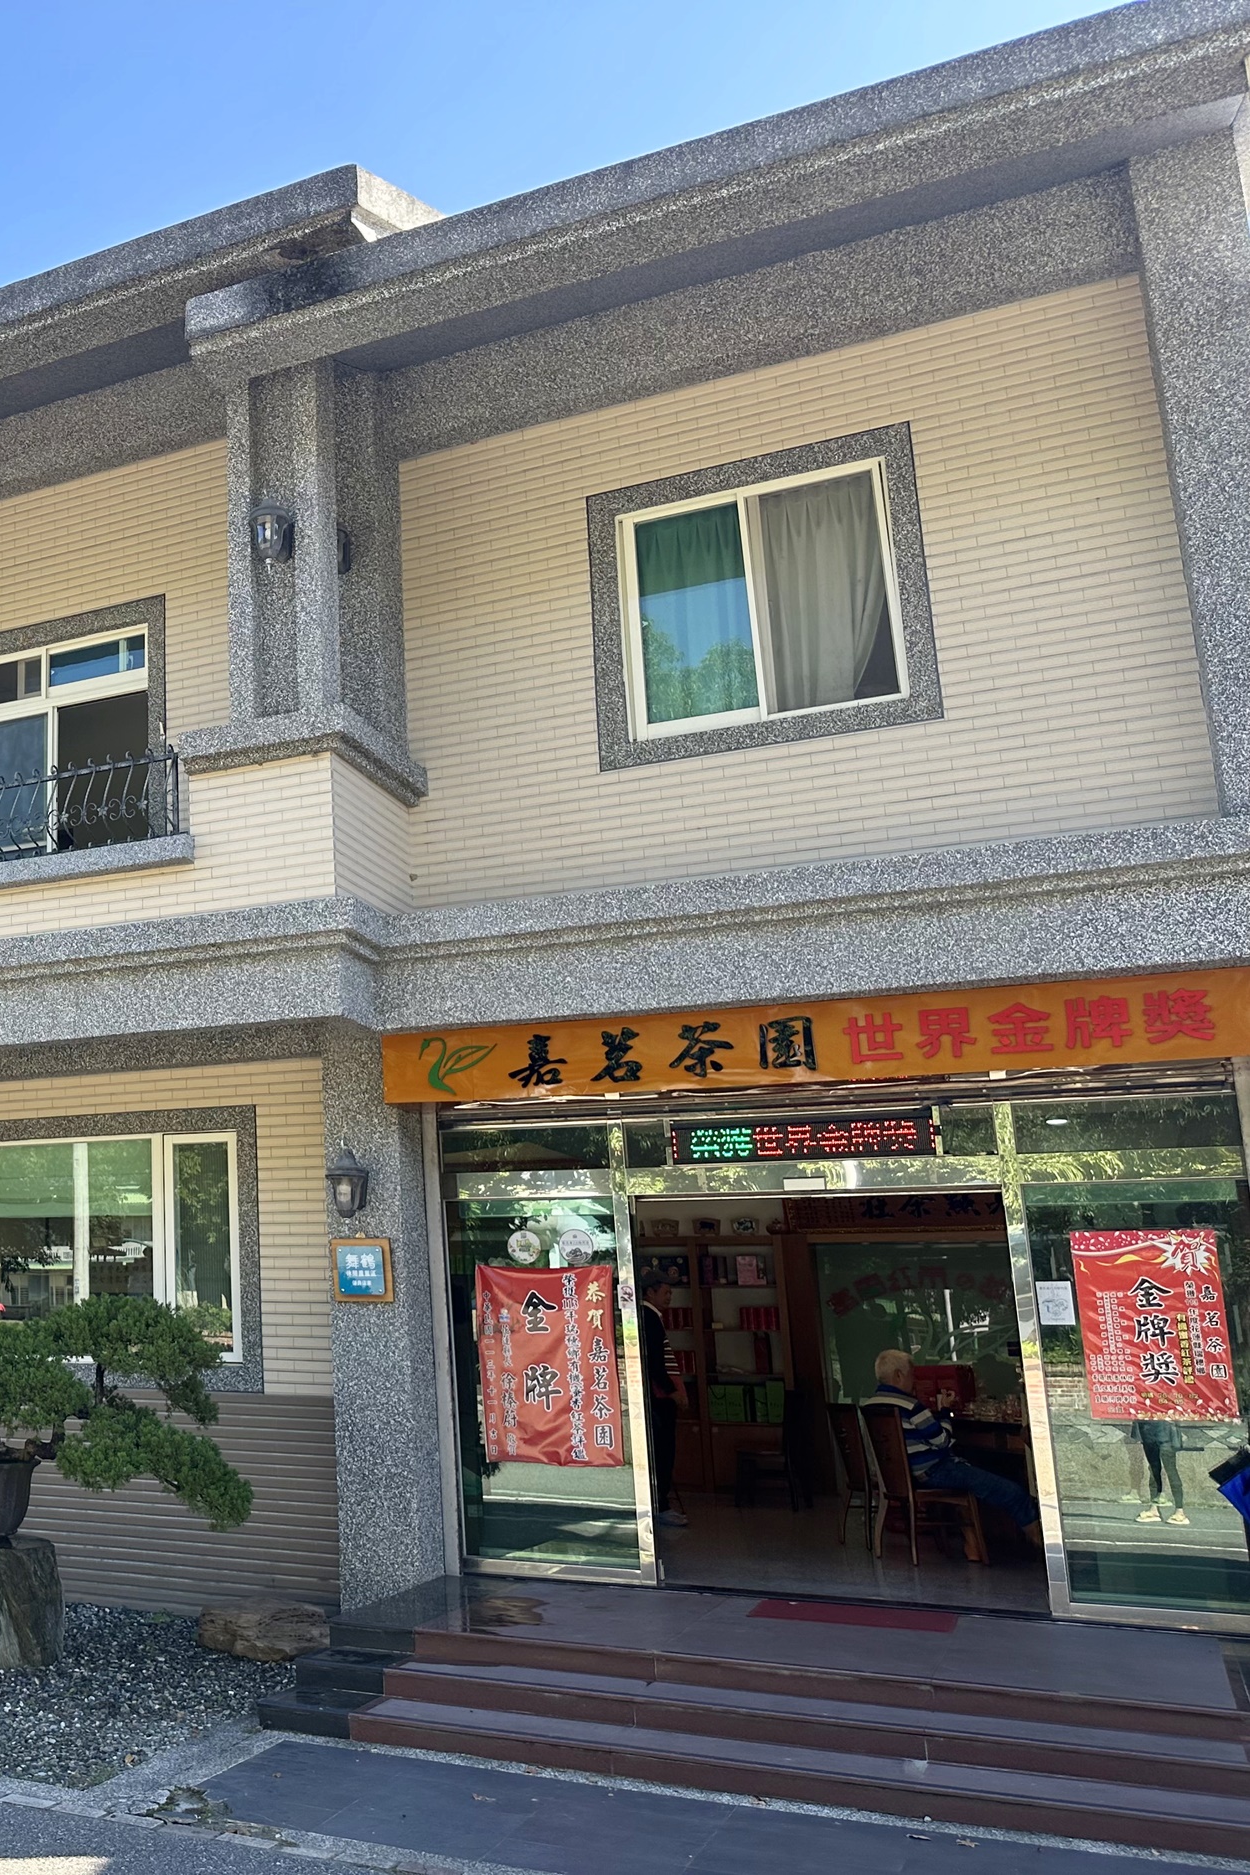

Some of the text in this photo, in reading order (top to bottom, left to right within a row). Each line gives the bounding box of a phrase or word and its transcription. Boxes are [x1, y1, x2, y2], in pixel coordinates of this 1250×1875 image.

[508, 987, 1216, 1088] 嘉茗茶園 世界金牌獎
[345, 1253, 376, 1269] 舞鶴
[1170, 1239, 1201, 1271] 賀
[520, 1290, 563, 1411] 金牌
[585, 1281, 614, 1450] 恭賀 嘉茗茶園
[1127, 1276, 1180, 1386] 金牌獎
[1199, 1285, 1228, 1379] 嘉茗茶園
